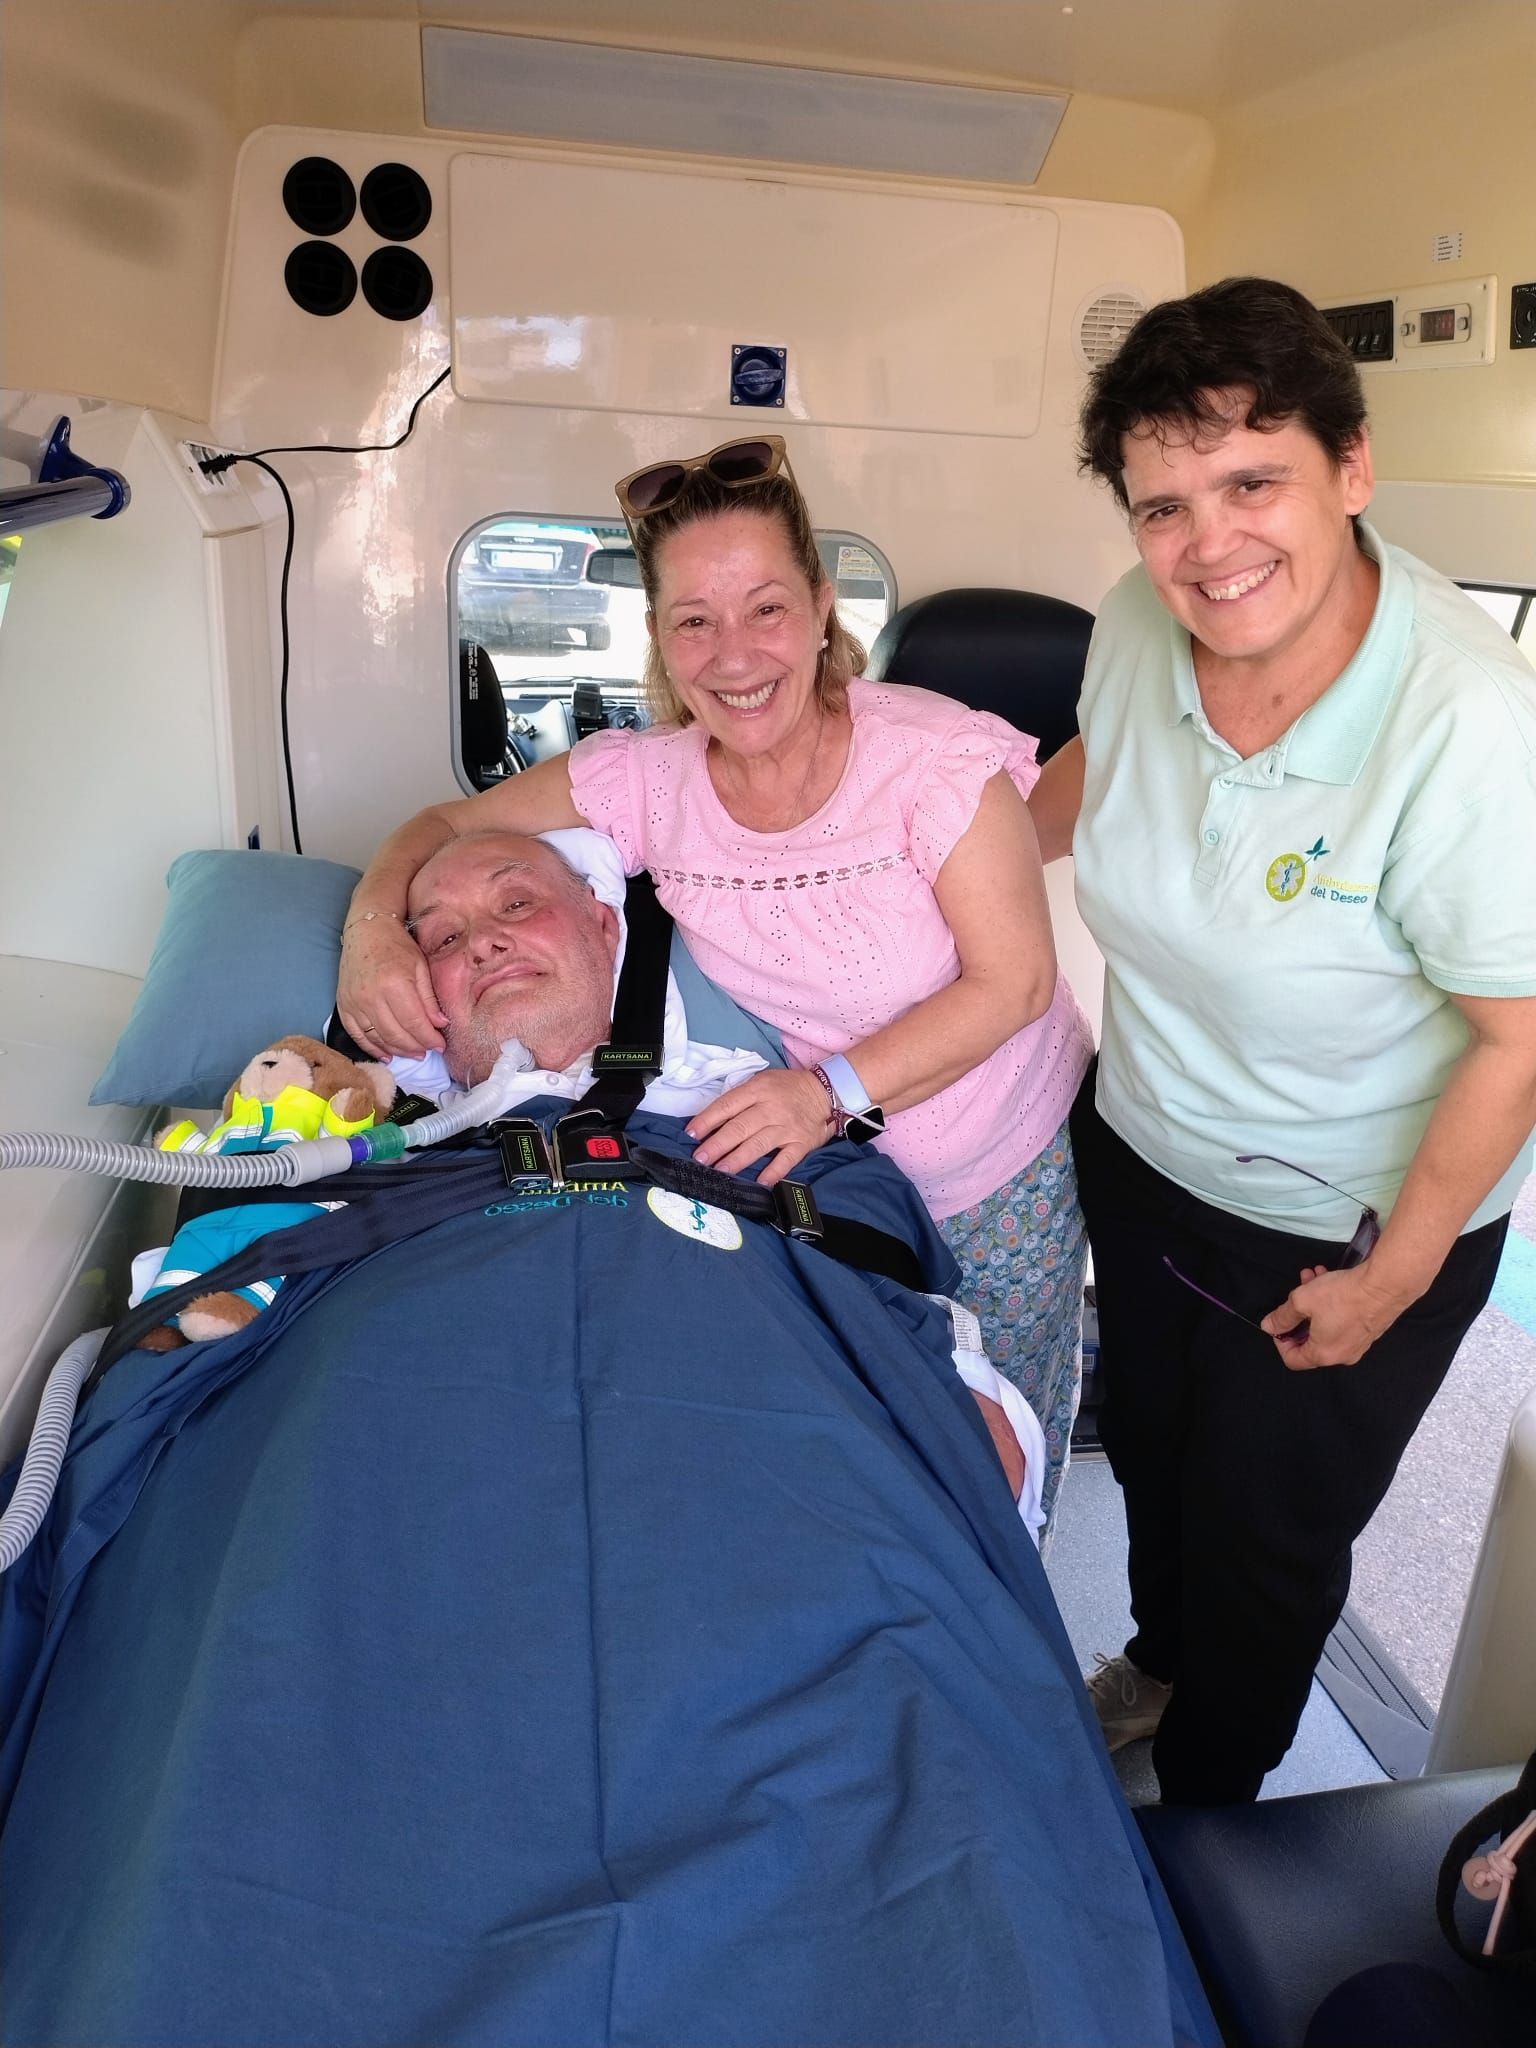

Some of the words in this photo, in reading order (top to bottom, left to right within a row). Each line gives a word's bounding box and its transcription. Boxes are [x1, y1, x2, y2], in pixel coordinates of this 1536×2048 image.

[1311, 885, 1326, 899] del
[1330, 890, 1368, 903] Deseo
[521, 1137, 535, 1169] KARTSANA
[795, 1189, 810, 1222] KARTSANA
